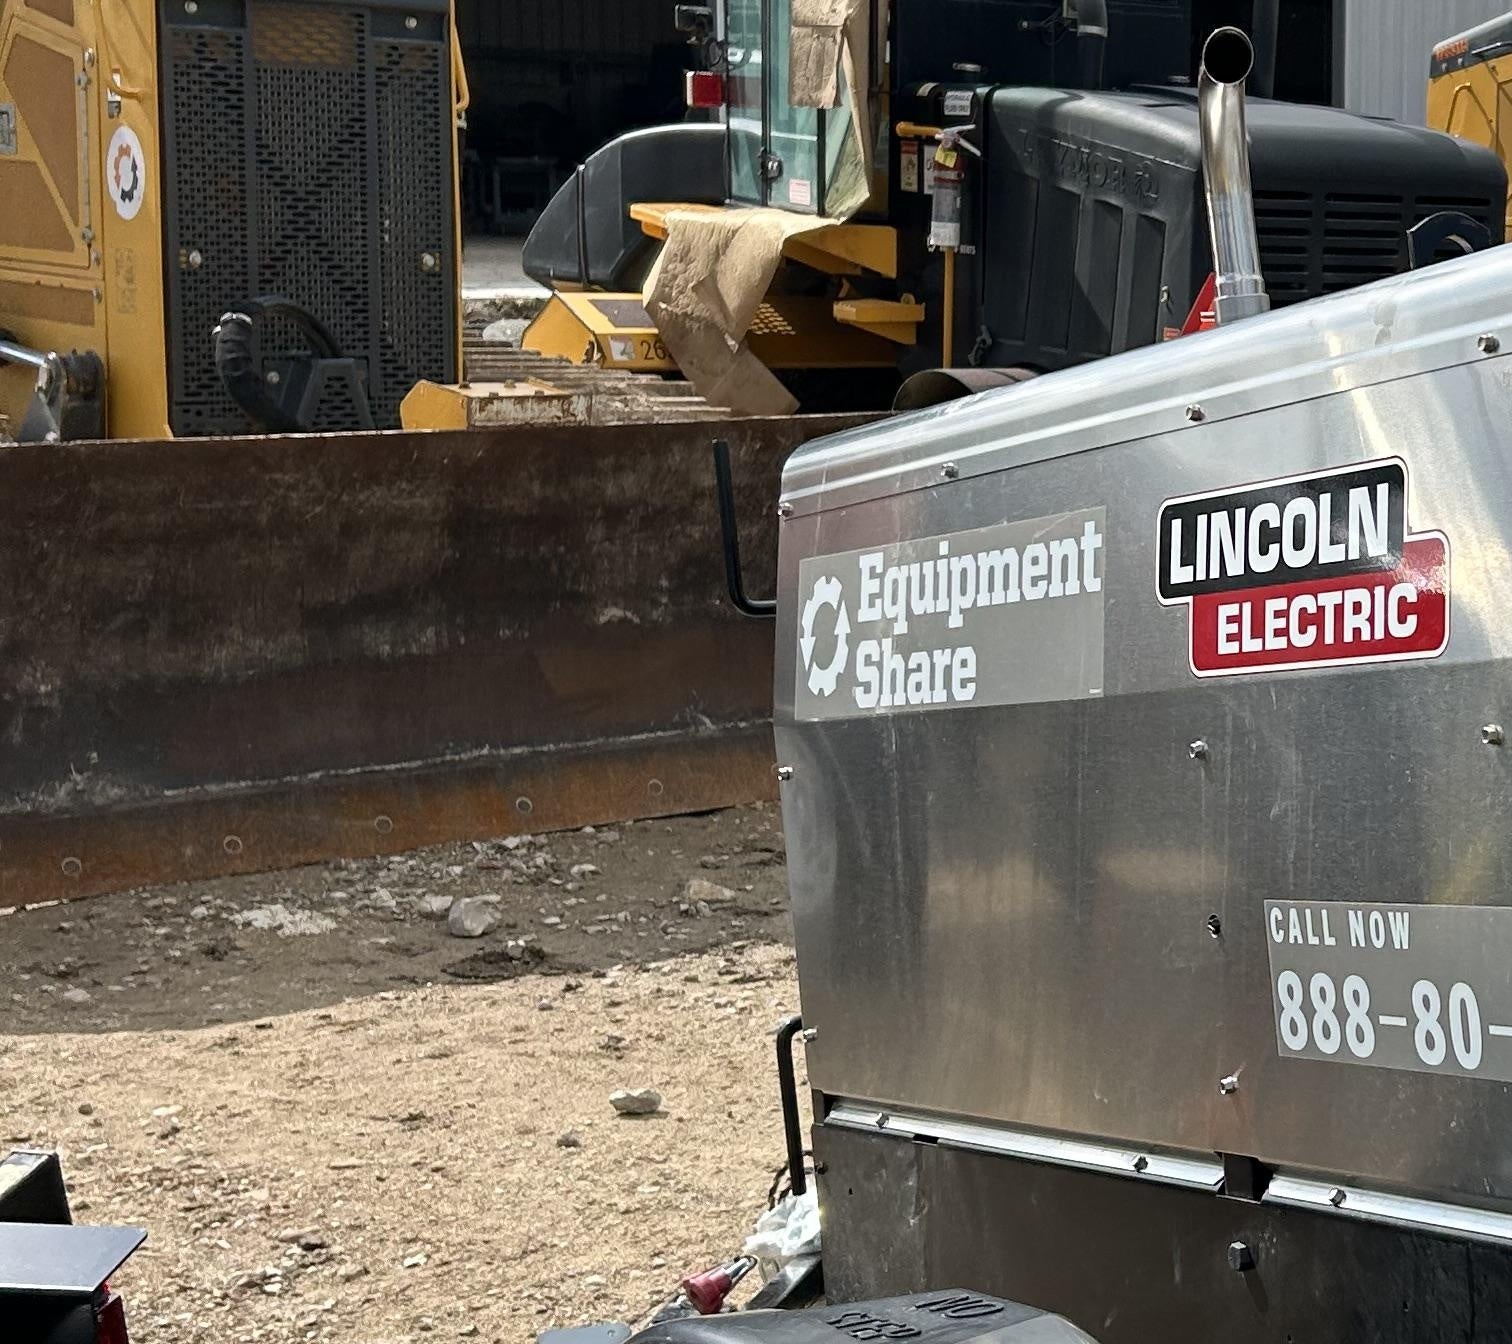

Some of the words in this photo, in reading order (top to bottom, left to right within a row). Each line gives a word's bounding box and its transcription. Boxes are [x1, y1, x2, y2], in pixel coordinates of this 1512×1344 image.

[1170, 482, 1389, 584] LINCOLN
[857, 520, 1102, 635] Equipment
[1217, 583, 1418, 655] ELECTRIC
[855, 638, 977, 708] Share
[1269, 907, 1336, 946] CALL
[1349, 910, 1410, 949] NOW
[826, 1312, 922, 1340] STEP
[914, 1295, 1004, 1318] NO
